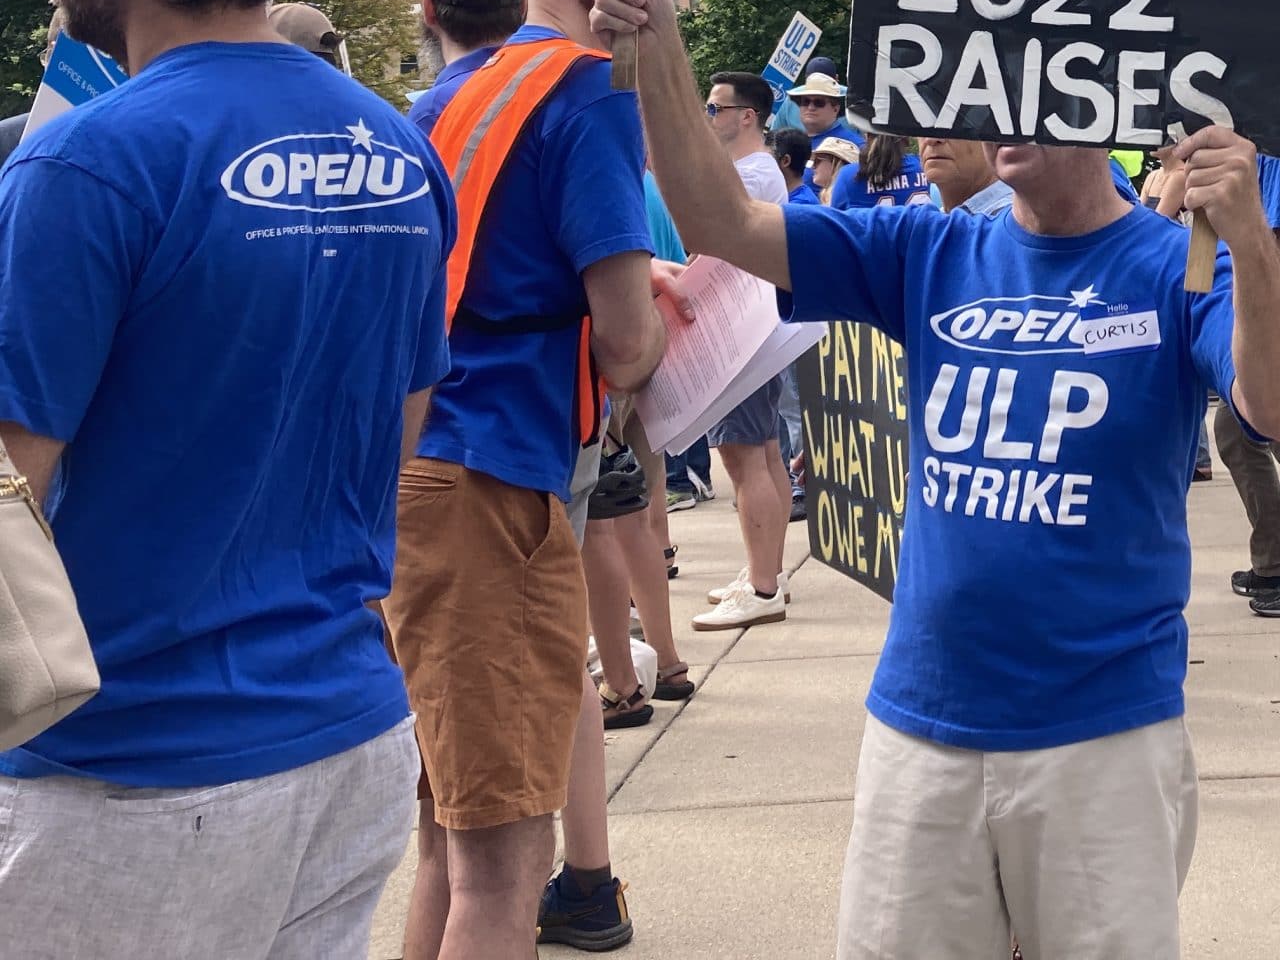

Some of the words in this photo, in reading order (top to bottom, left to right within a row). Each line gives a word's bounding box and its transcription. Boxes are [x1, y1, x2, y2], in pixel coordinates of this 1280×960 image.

[774, 49, 801, 78] STRIKE
[784, 20, 816, 58] ULP
[871, 23, 1235, 147] RAISES
[243, 152, 406, 197] OPEIU
[246, 228, 275, 240] OFFICE
[350, 224, 411, 234] INTERNATIONAL
[412, 226, 429, 235] UNION
[1084, 320, 1147, 345] CURTIS
[818, 321, 861, 404] PAY
[871, 326, 906, 421] ME
[924, 363, 1109, 464] ULP
[803, 409, 875, 498] WHAT
[922, 456, 1093, 526] STRIKE
[817, 490, 868, 574] OWE
